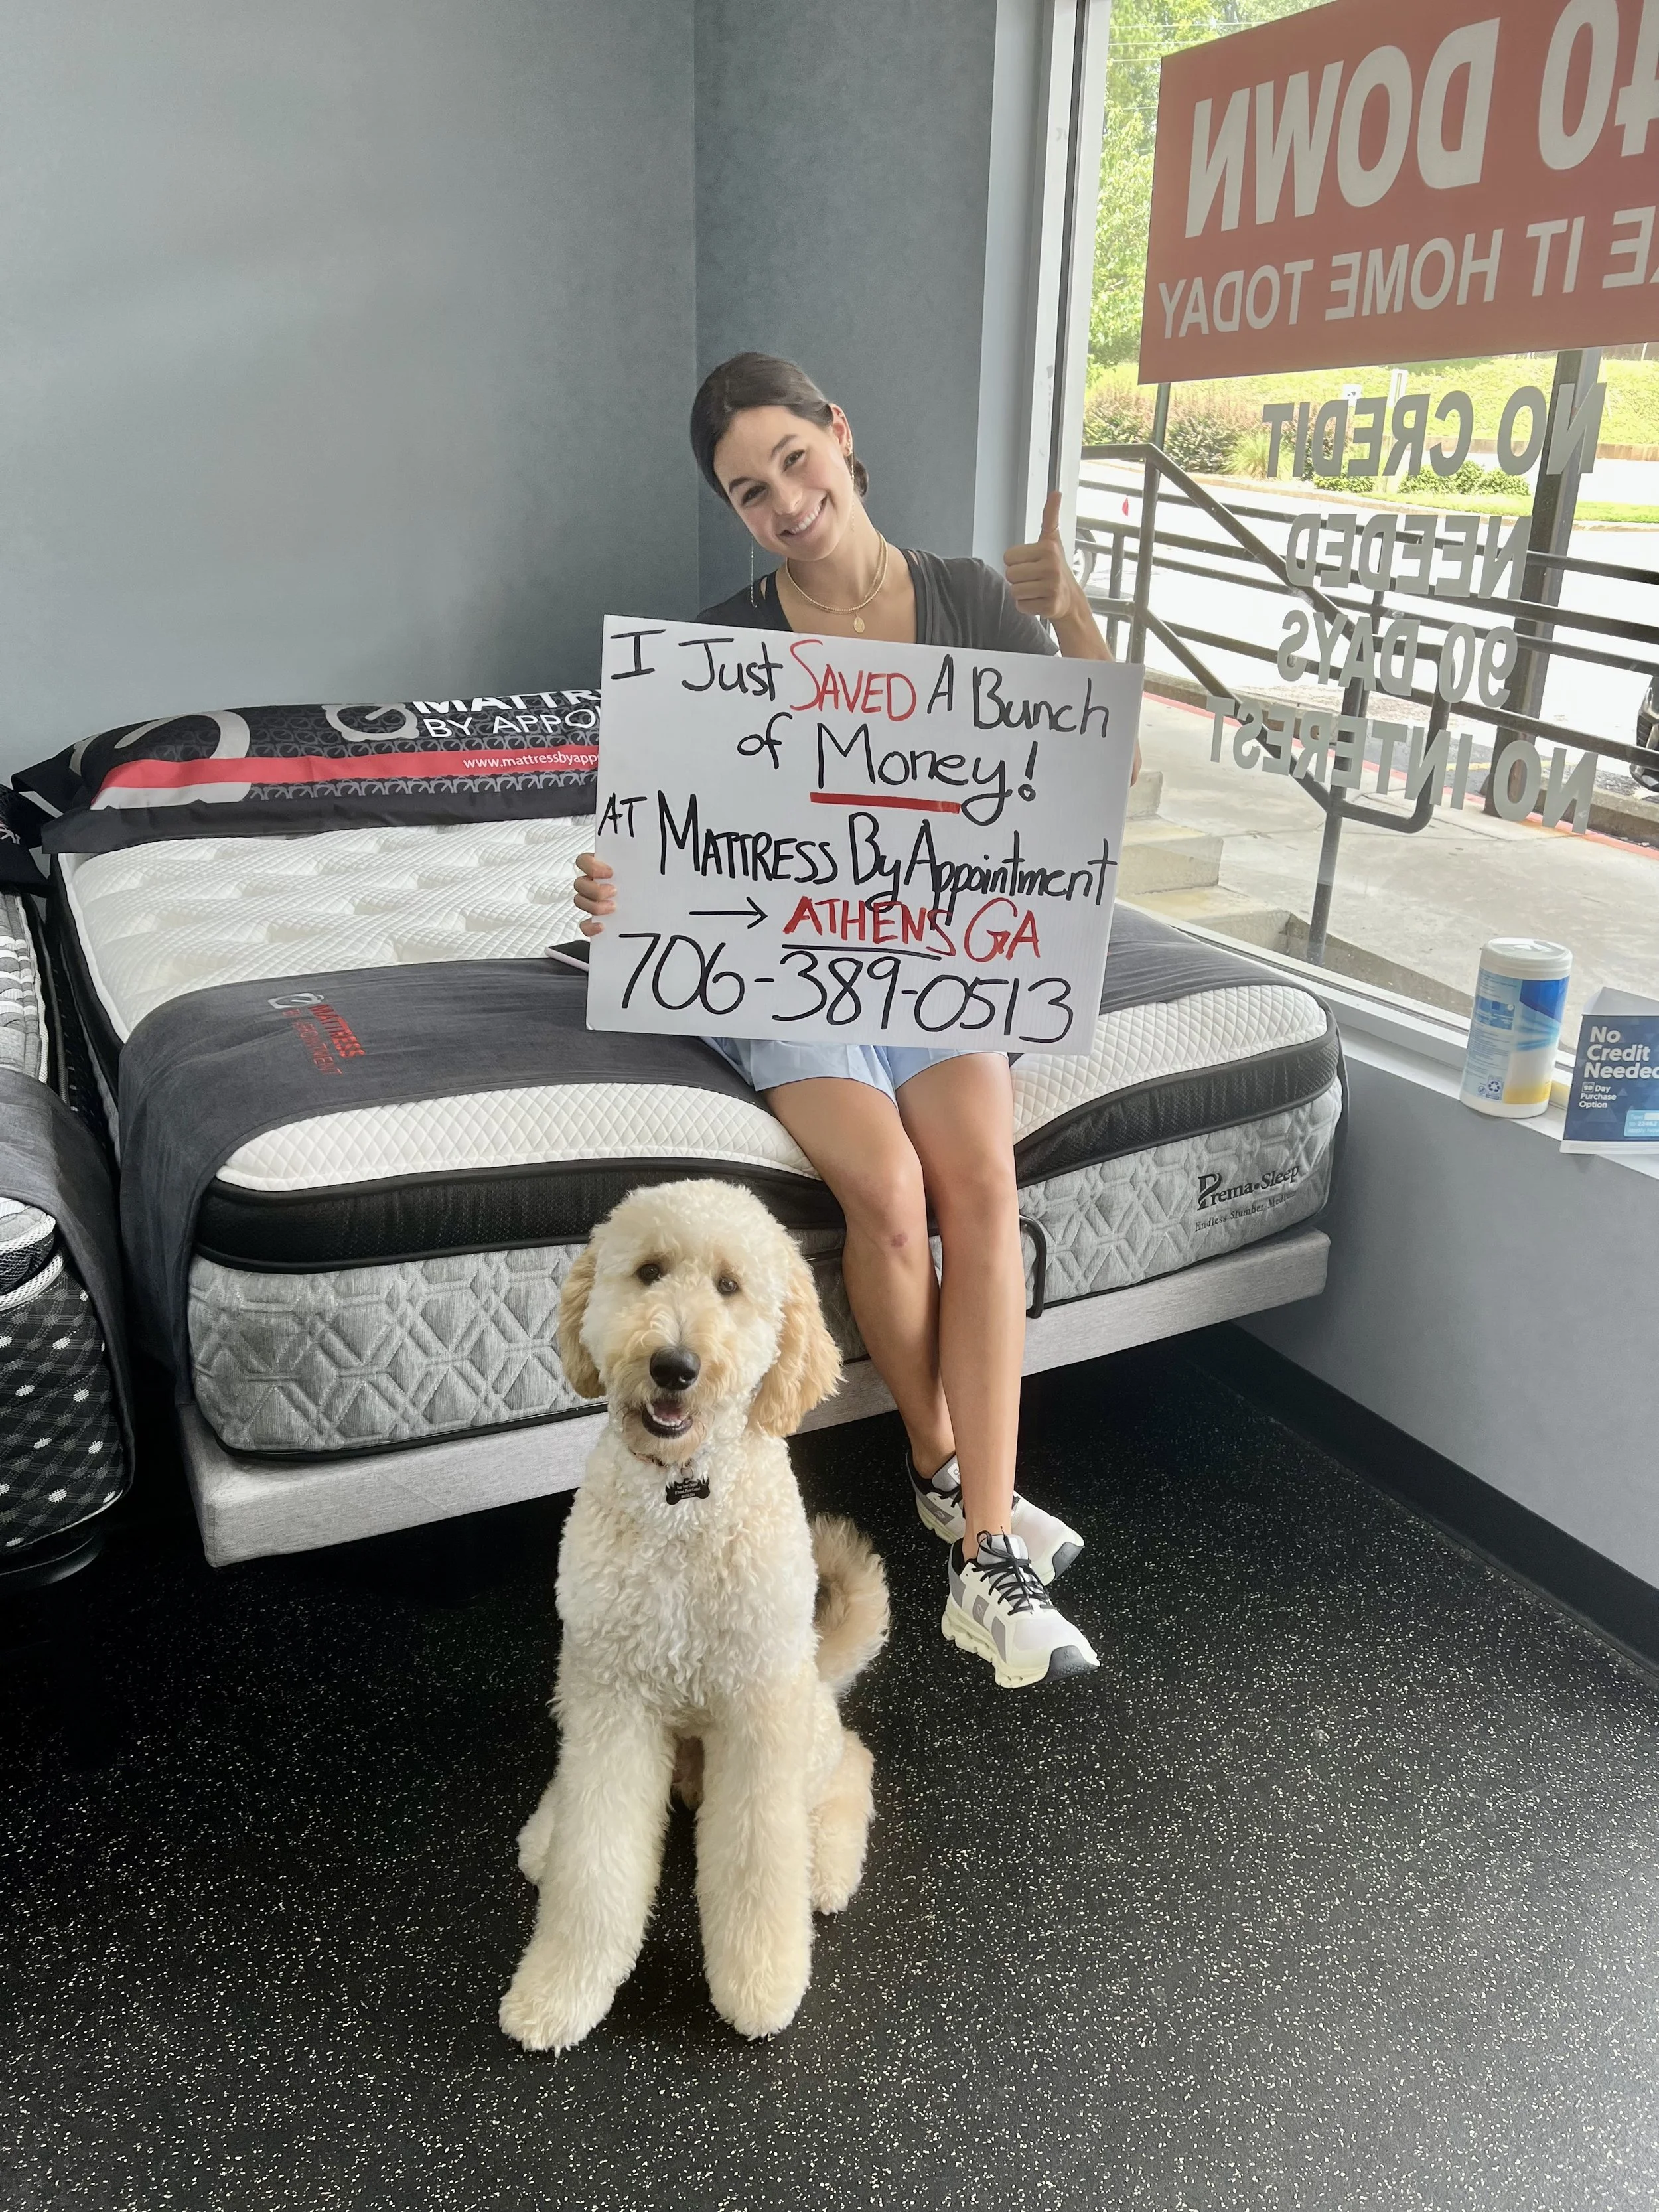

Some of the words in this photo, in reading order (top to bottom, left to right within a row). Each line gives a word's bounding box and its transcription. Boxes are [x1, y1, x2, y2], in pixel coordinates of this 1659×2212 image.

[611, 629, 666, 680] I
[678, 638, 783, 700] Just
[789, 640, 916, 721] SAVED
[927, 654, 954, 714] A
[973, 667, 1109, 738] Bunch
[413, 689, 601, 714] MATTR
[423, 717, 472, 737] BY
[492, 706, 601, 734] APPO
[463, 751, 599, 769] www.mattressbyapp
[737, 713, 793, 769] of
[818, 723, 1038, 825] Money!
[597, 792, 646, 837] AT
[658, 790, 838, 885] MATTRESS
[849, 812, 901, 912] By
[904, 820, 1117, 926] Appointment
[783, 897, 955, 958] ATHENS
[966, 897, 1041, 962] GA
[618, 934, 1073, 1043] 706-389-0513
[308, 1004, 365, 1057] MATTRESS
[1590, 1026, 1621, 1043] No
[1587, 1044, 1651, 1061] Credit
[1595, 1085, 1611, 1094] Day
[1579, 1100, 1607, 1109] Option
[1195, 1215, 1227, 1232] Endless
[1230, 1204, 1264, 1220] Slumber
